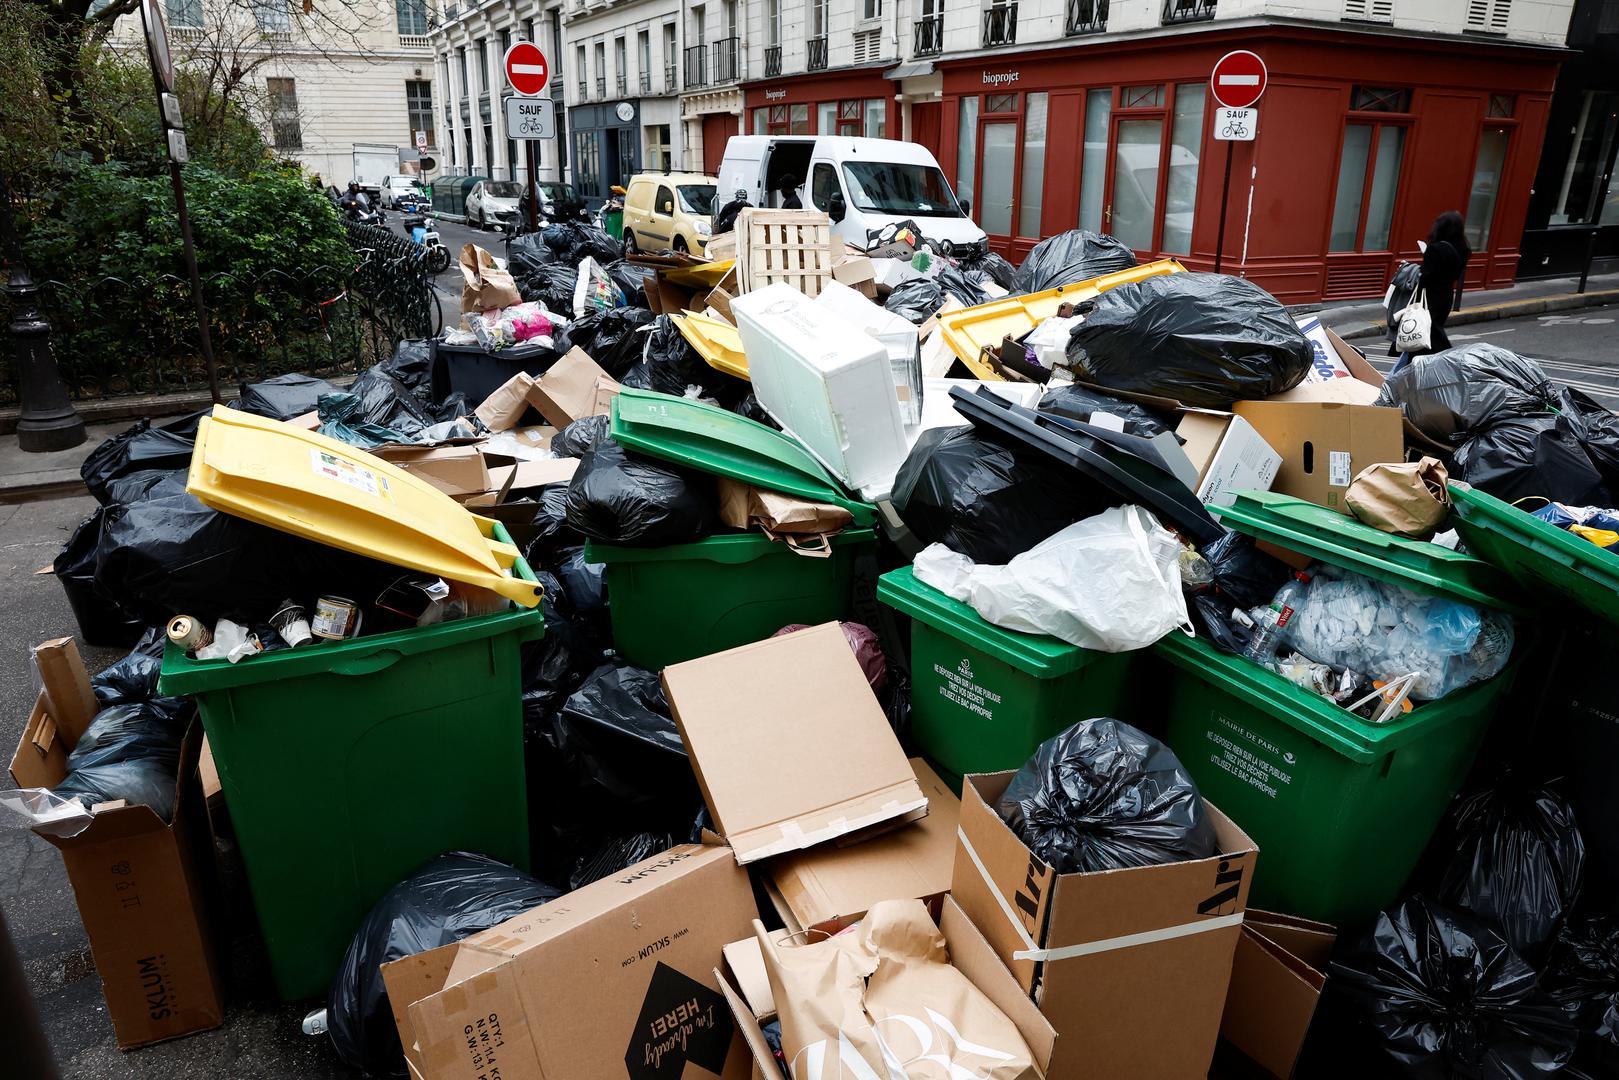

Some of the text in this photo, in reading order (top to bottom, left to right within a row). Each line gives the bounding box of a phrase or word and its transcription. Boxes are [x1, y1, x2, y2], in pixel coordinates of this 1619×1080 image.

[982, 69, 1019, 86] bioprojet
[765, 89, 786, 101] bioprojet
[519, 104, 542, 115] SAUF
[1226, 110, 1248, 118] SAUF
[940, 686, 955, 701] UTILISEZ
[961, 697, 969, 708] BAC
[949, 681, 959, 693] TRIEZ
[974, 684, 983, 695] VOIE
[983, 688, 1001, 704] PUBLIQUE
[1218, 717, 1281, 755] MAIRIE DE PARIS
[1207, 731, 1213, 740] NE
[1233, 745, 1242, 756] RIEN
[1243, 750, 1252, 762] SUR
[1252, 755, 1258, 766] LA
[1258, 759, 1269, 772] VOIE
[1269, 765, 1291, 785] PUBLIQUE
[1211, 754, 1231, 771] UTILISEZ
[1232, 766, 1239, 776] LE
[1239, 770, 1248, 782] BAC
[1223, 750, 1237, 764] TRIEZ
[1237, 758, 1247, 770] VOS
[620, 852, 691, 884] SKLUM
[136, 955, 171, 1020] SKLUM
[488, 1013, 504, 1047] QTY:1
[650, 997, 700, 1039] HERE!
[643, 1022, 694, 1069] already
